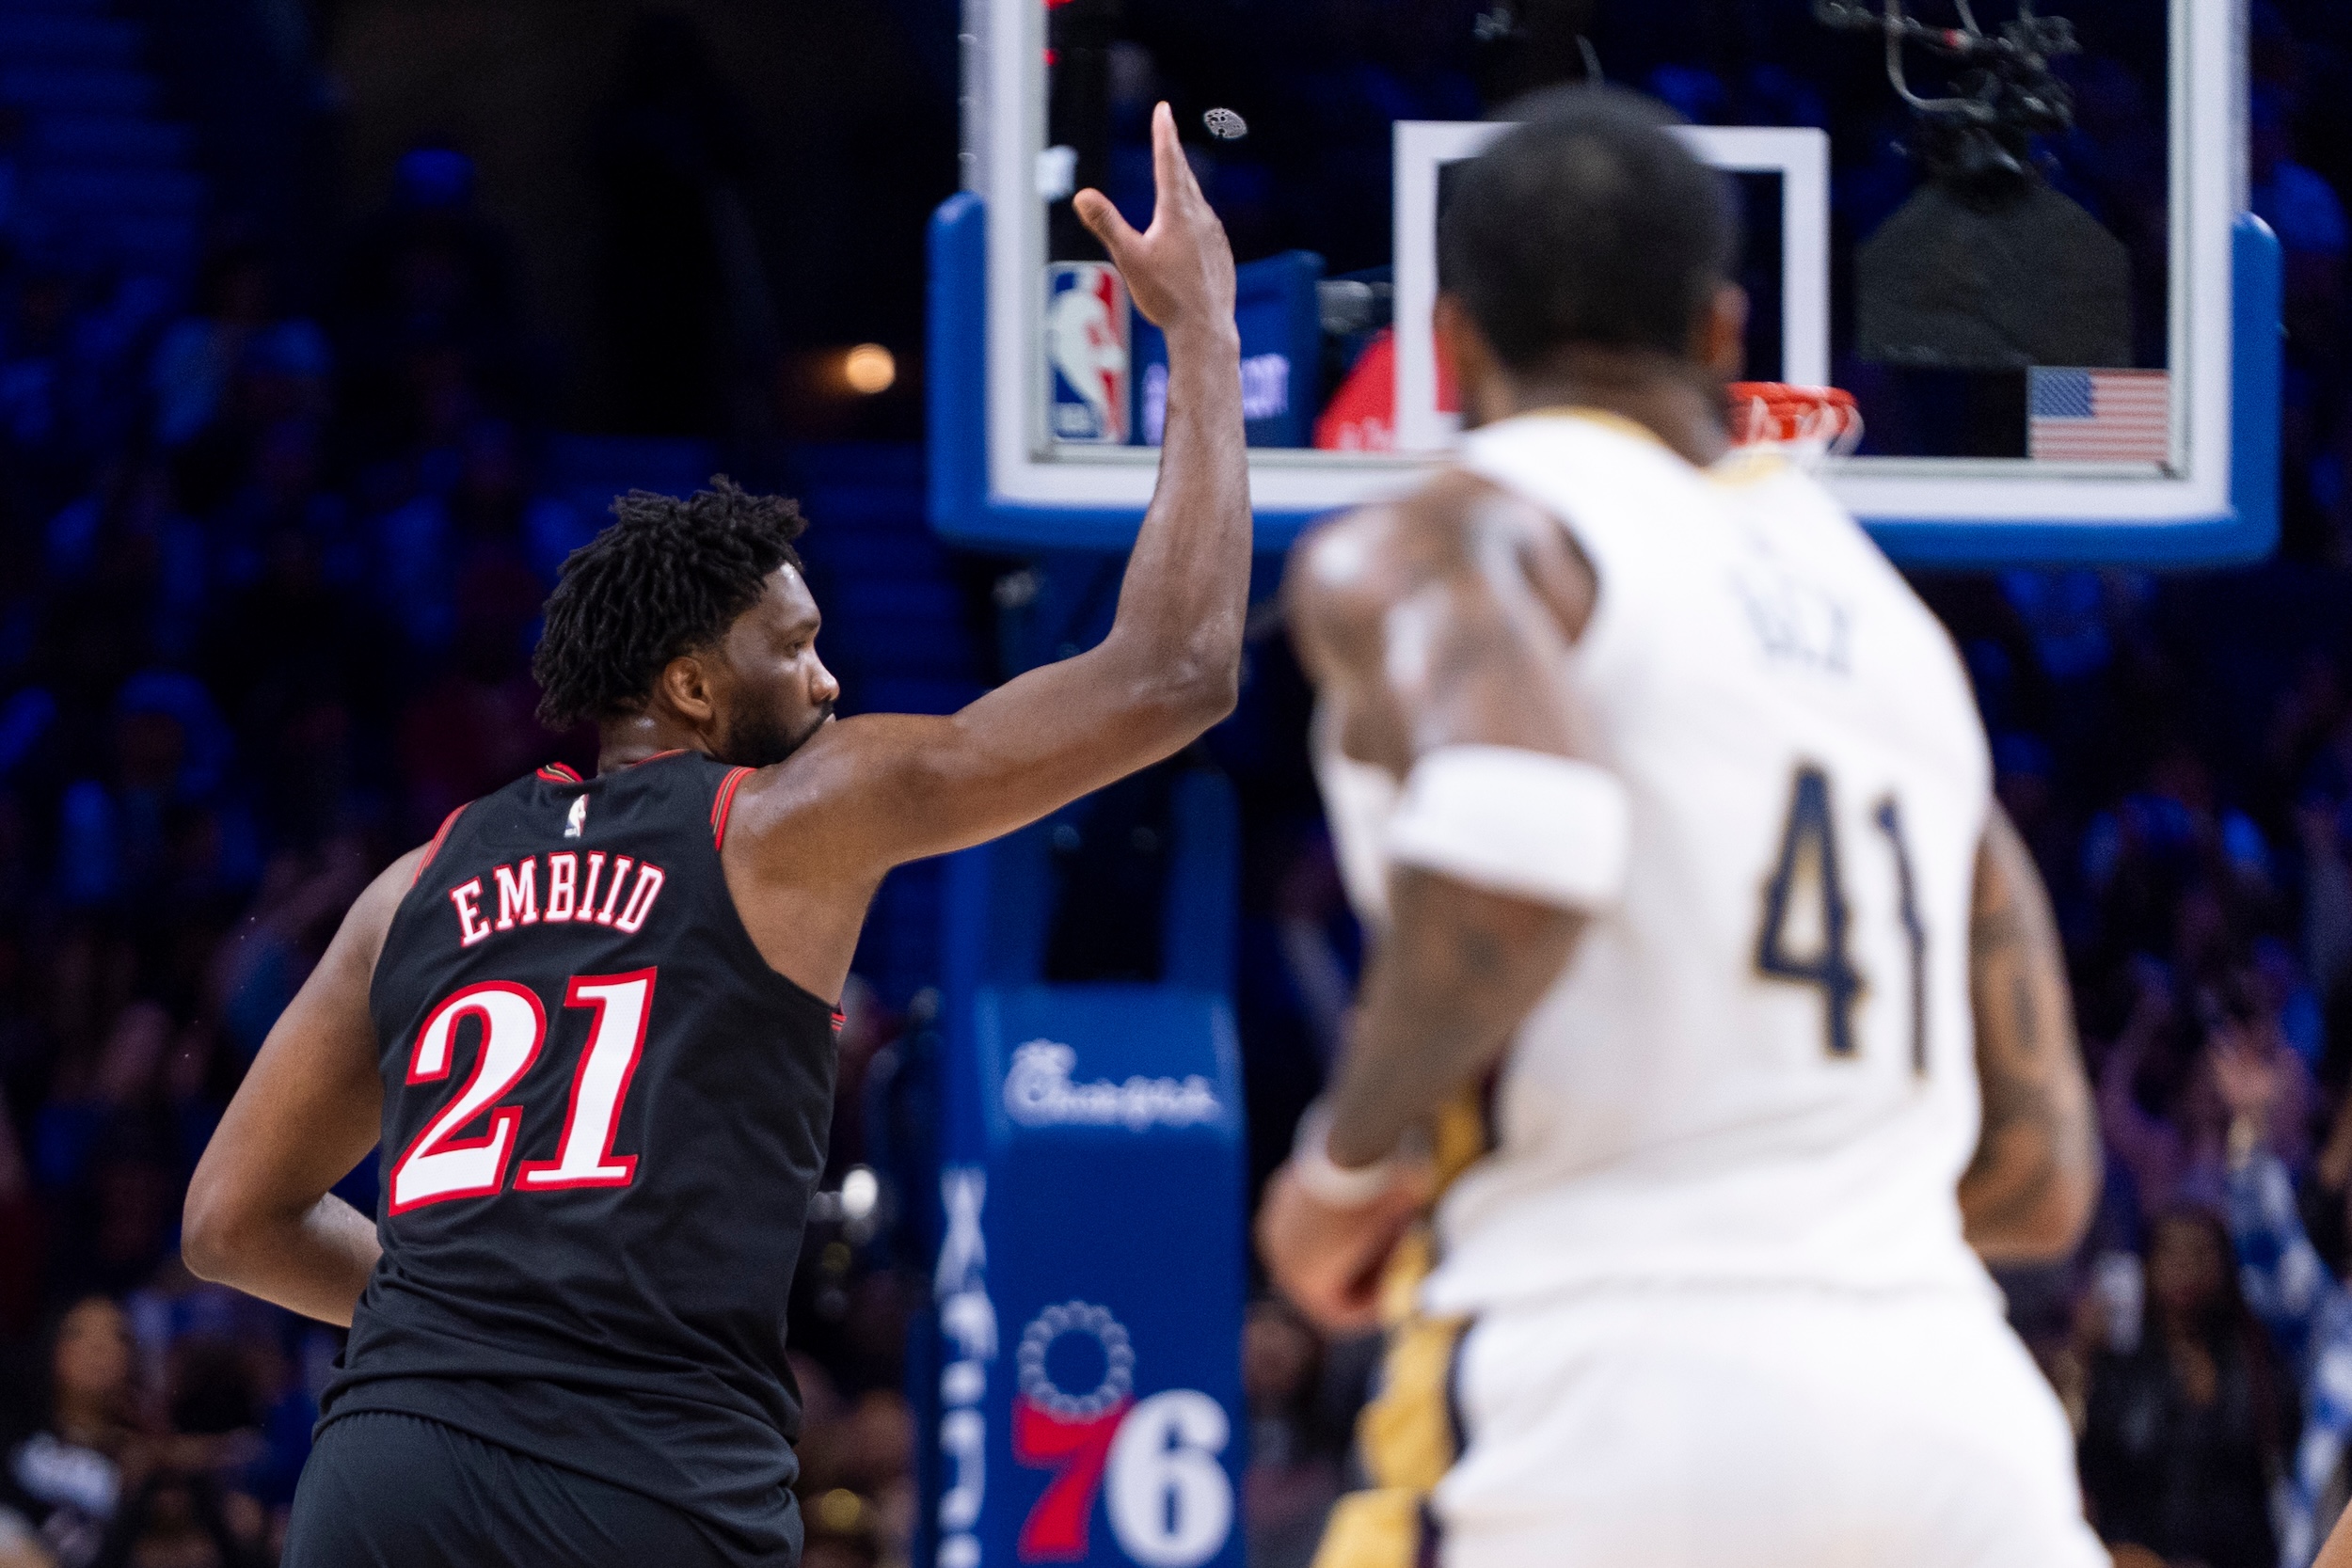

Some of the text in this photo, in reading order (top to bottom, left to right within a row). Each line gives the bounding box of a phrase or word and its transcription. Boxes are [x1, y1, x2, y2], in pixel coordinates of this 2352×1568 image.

[450, 850, 665, 947] EMBIID
[1750, 760, 1931, 1085] 41
[389, 966, 657, 1216] 21
[1014, 1390, 1232, 1565] 76
